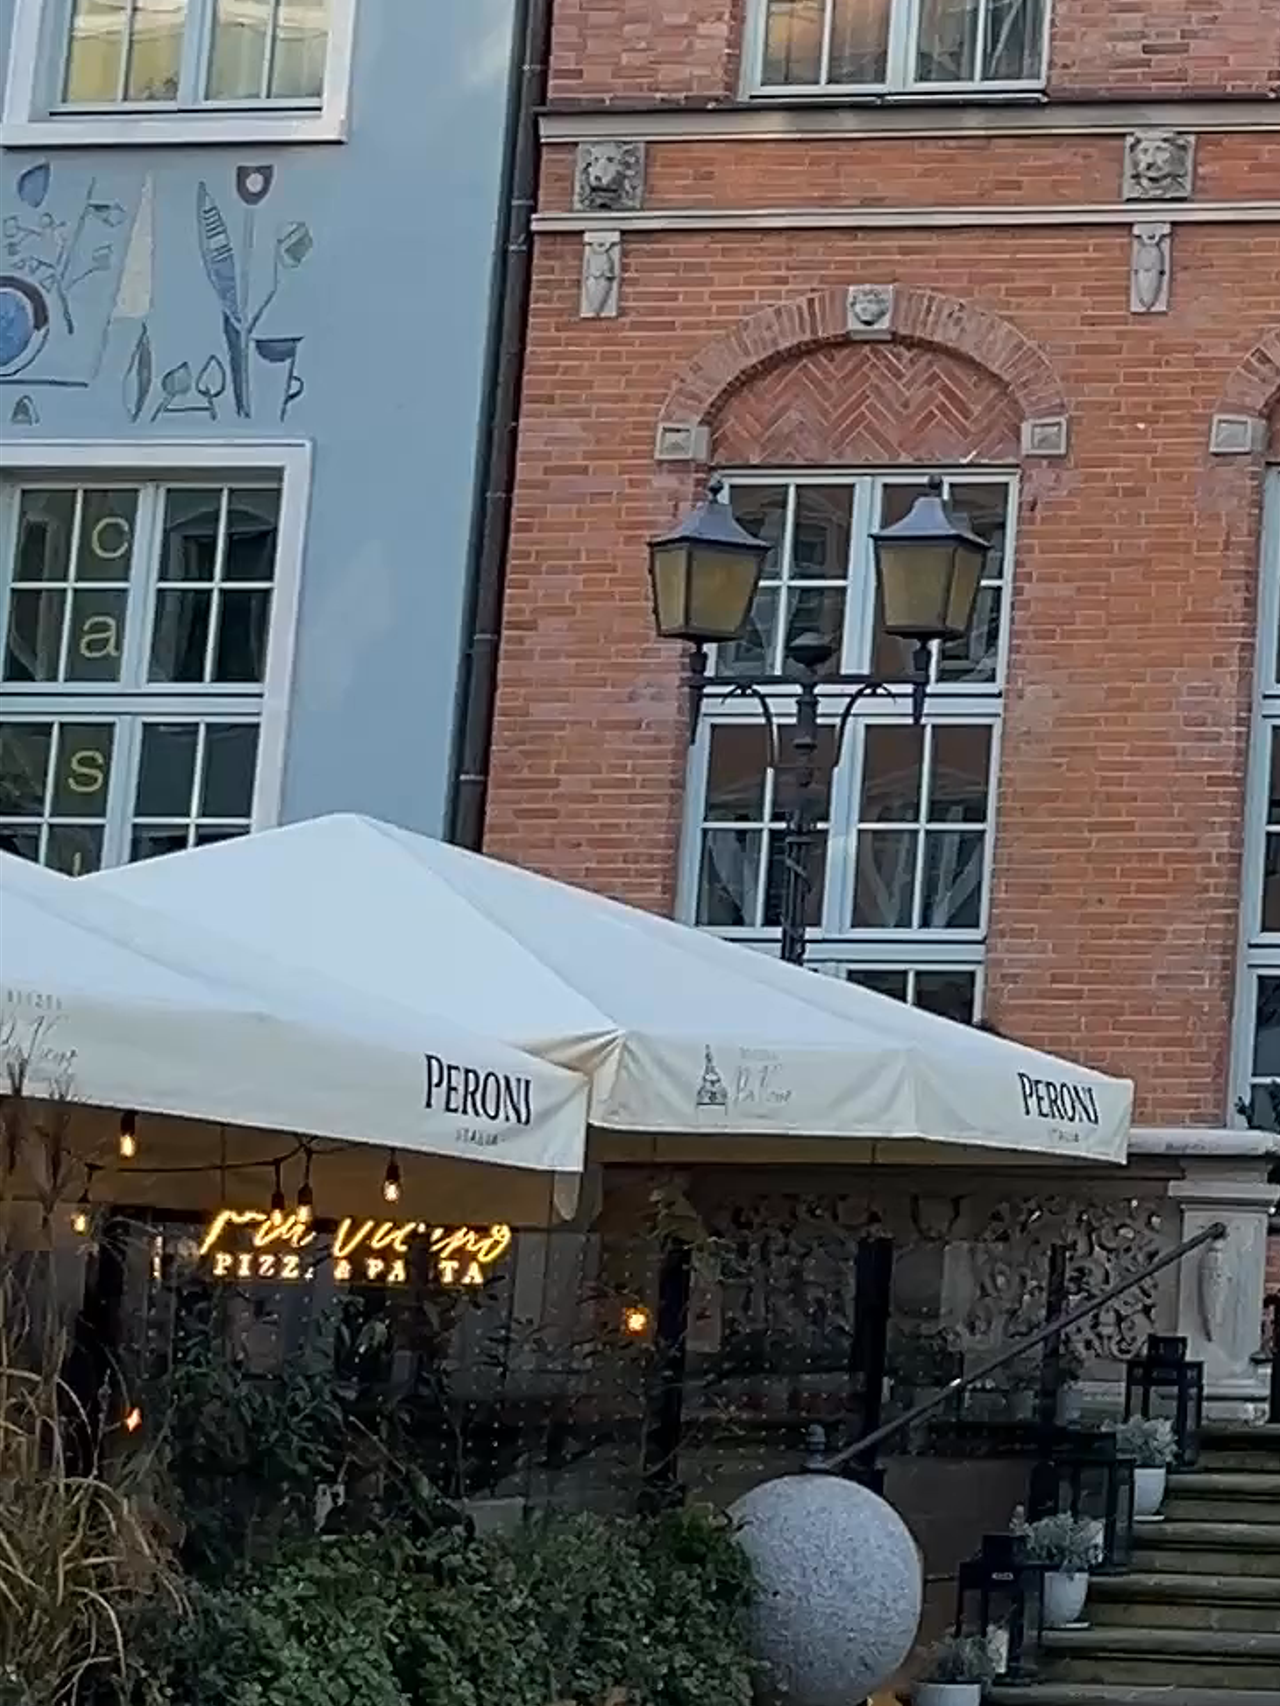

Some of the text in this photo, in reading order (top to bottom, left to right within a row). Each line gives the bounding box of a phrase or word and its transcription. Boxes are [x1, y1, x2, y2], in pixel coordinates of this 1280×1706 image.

[424, 1053, 532, 1126] PERONI
[1016, 1071, 1099, 1125] PERONI
[212, 1252, 313, 1282] PIZZ
[366, 1257, 484, 1285] PATA
